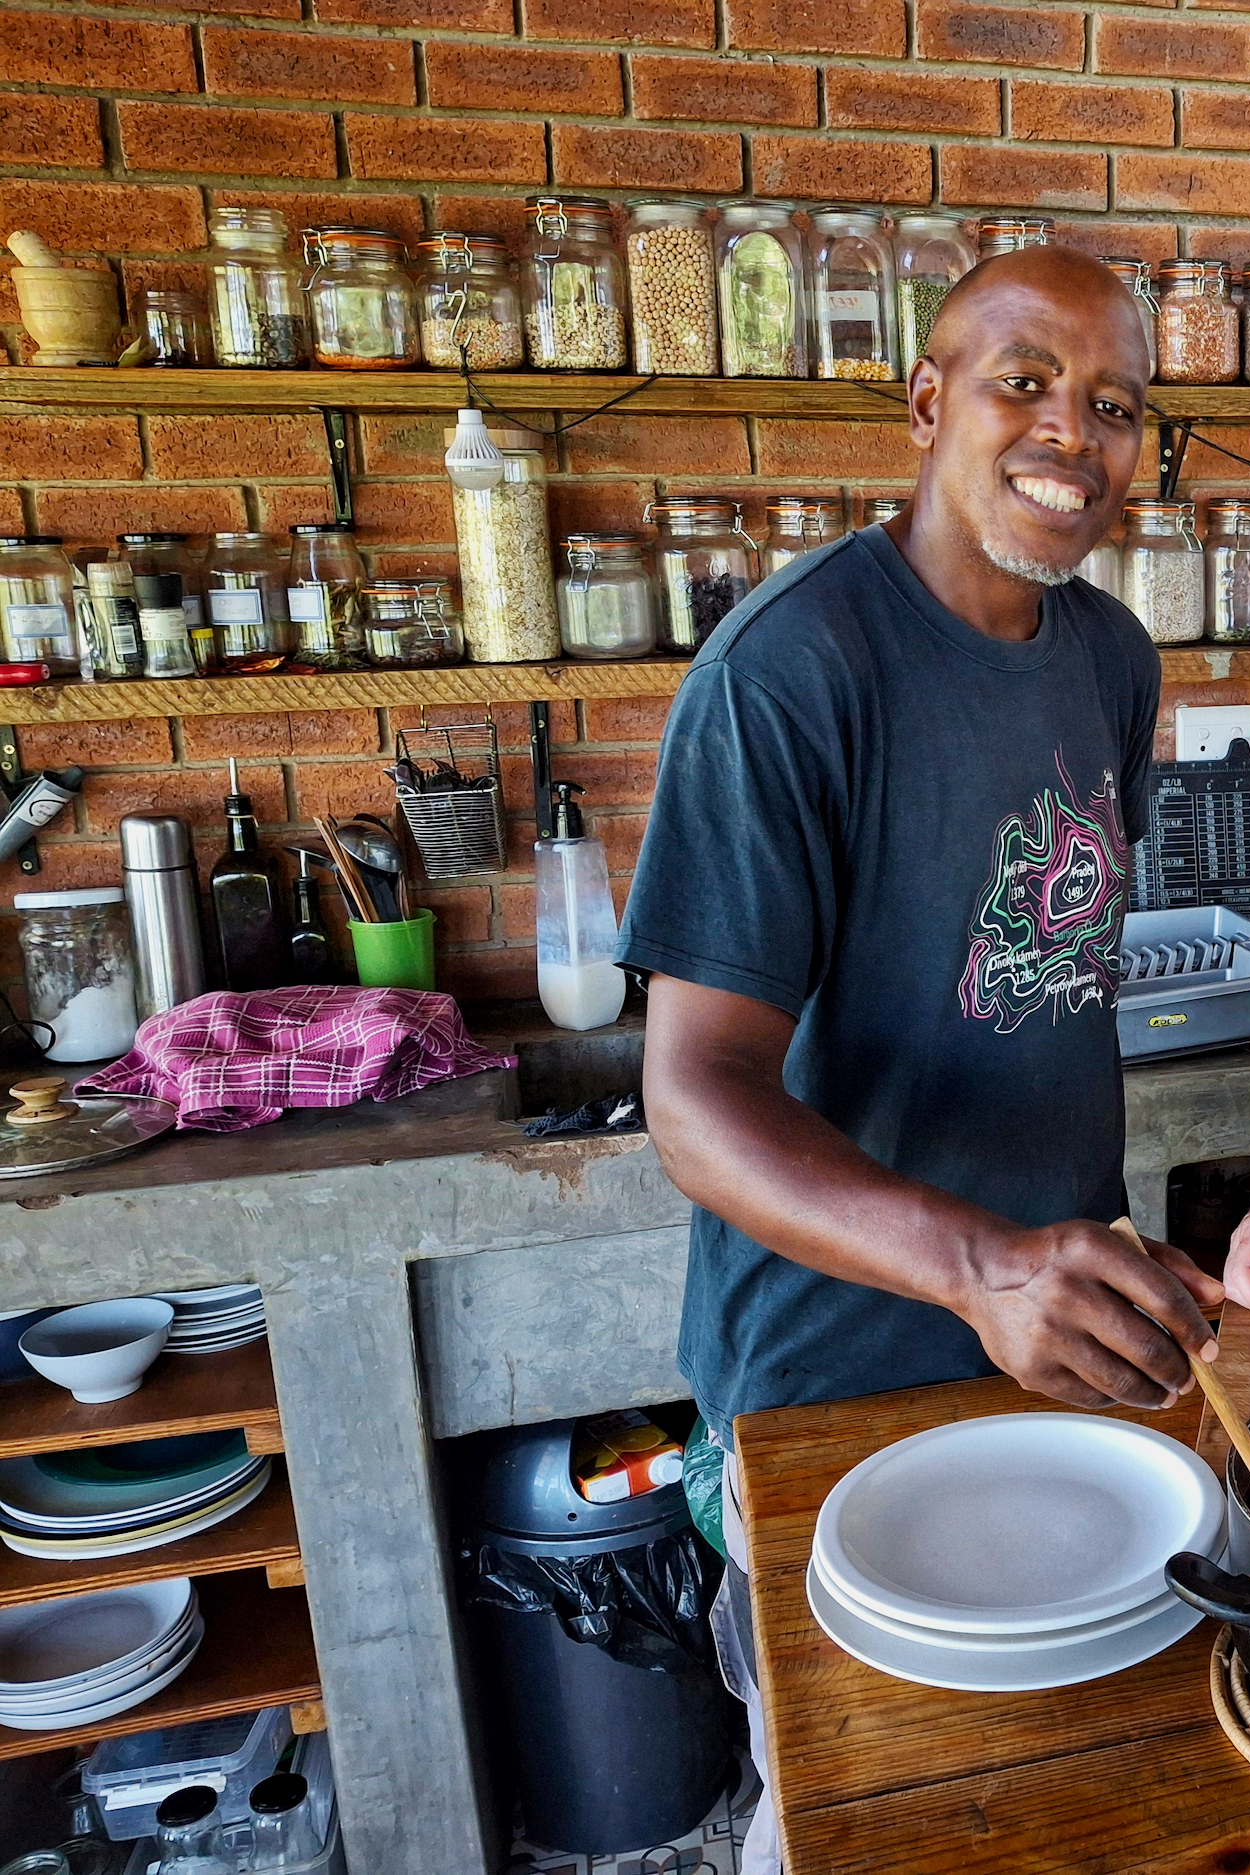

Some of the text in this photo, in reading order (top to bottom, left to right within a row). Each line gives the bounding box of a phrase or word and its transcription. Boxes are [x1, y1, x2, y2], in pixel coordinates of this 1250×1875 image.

[1158, 786, 1187, 795] IMPERIAL
[1067, 885, 1083, 899] 1491
[1015, 968, 1035, 985] 1285
